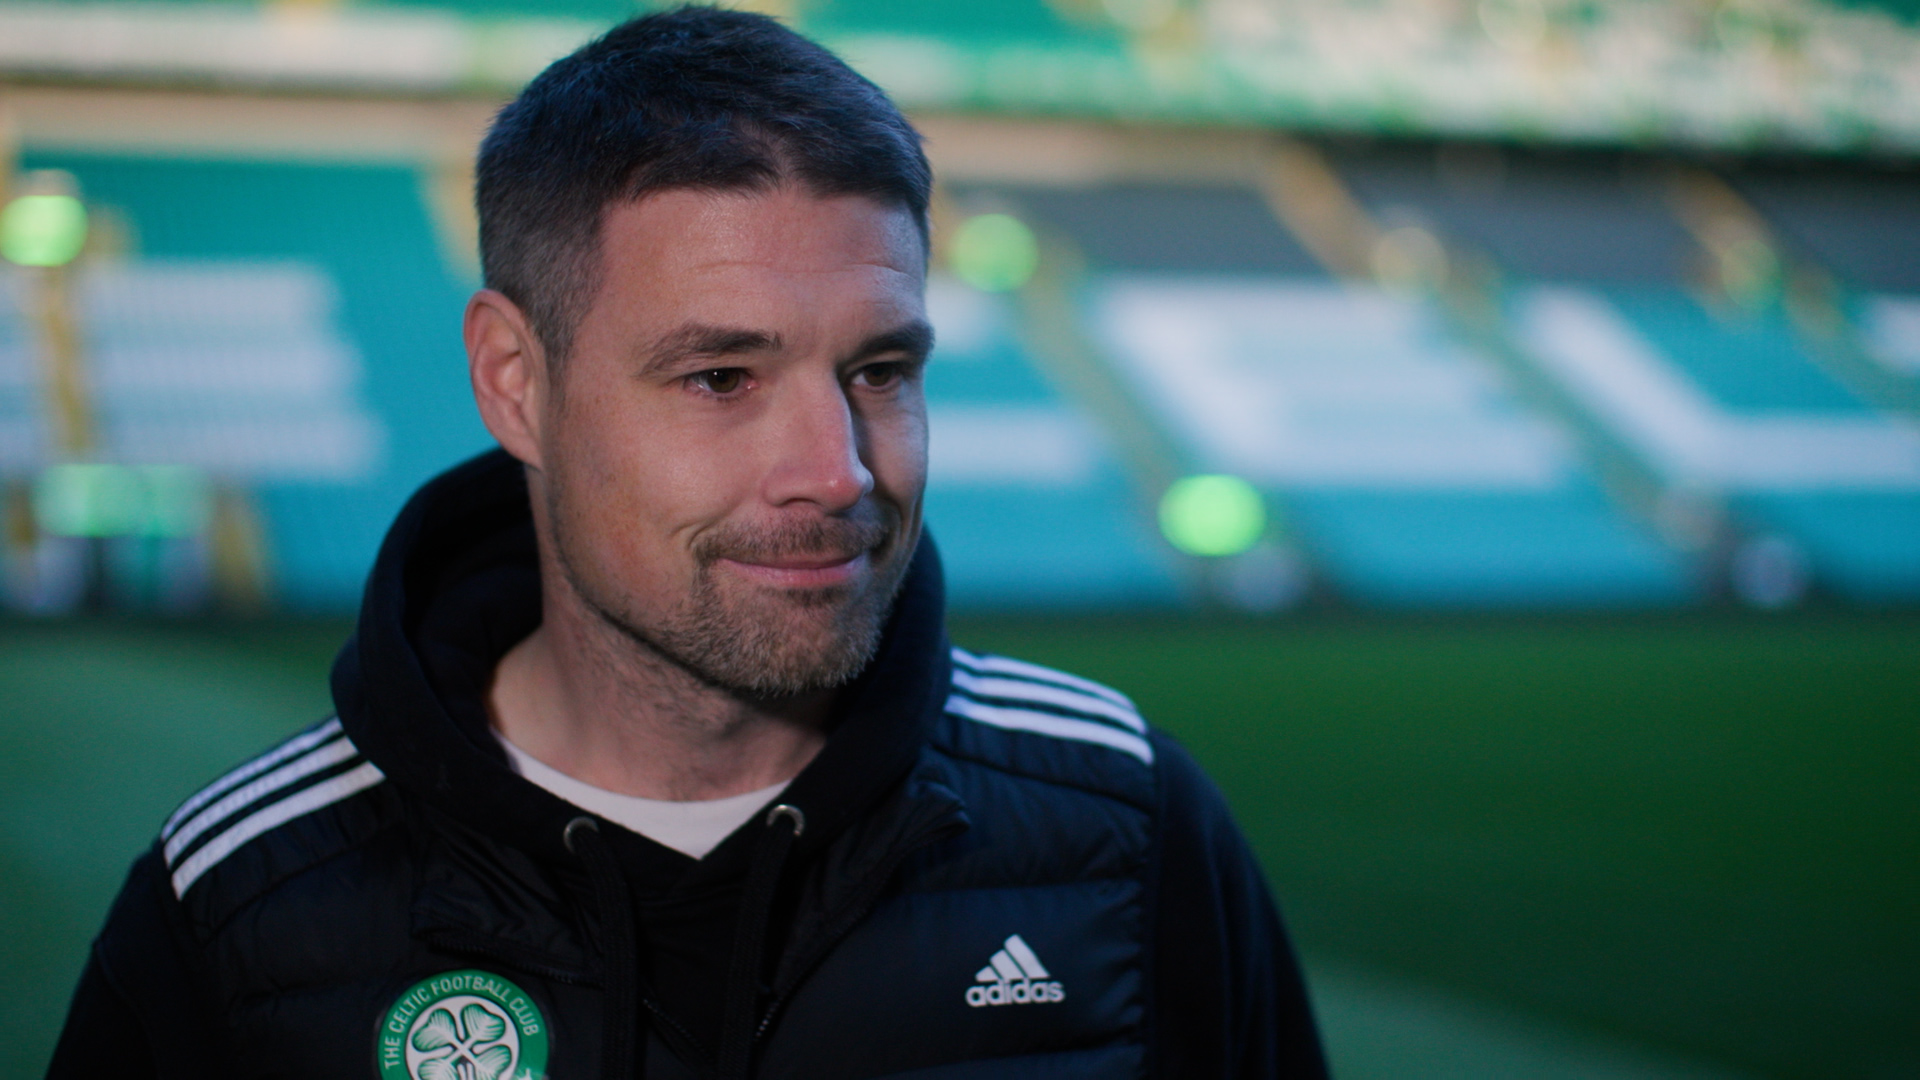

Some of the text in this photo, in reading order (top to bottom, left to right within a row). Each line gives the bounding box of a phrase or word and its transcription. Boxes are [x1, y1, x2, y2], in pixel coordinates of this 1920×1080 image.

[384, 975, 540, 1069] THE CELTIC FOOTBALL CLUB
[965, 978, 1065, 1007] adidas
